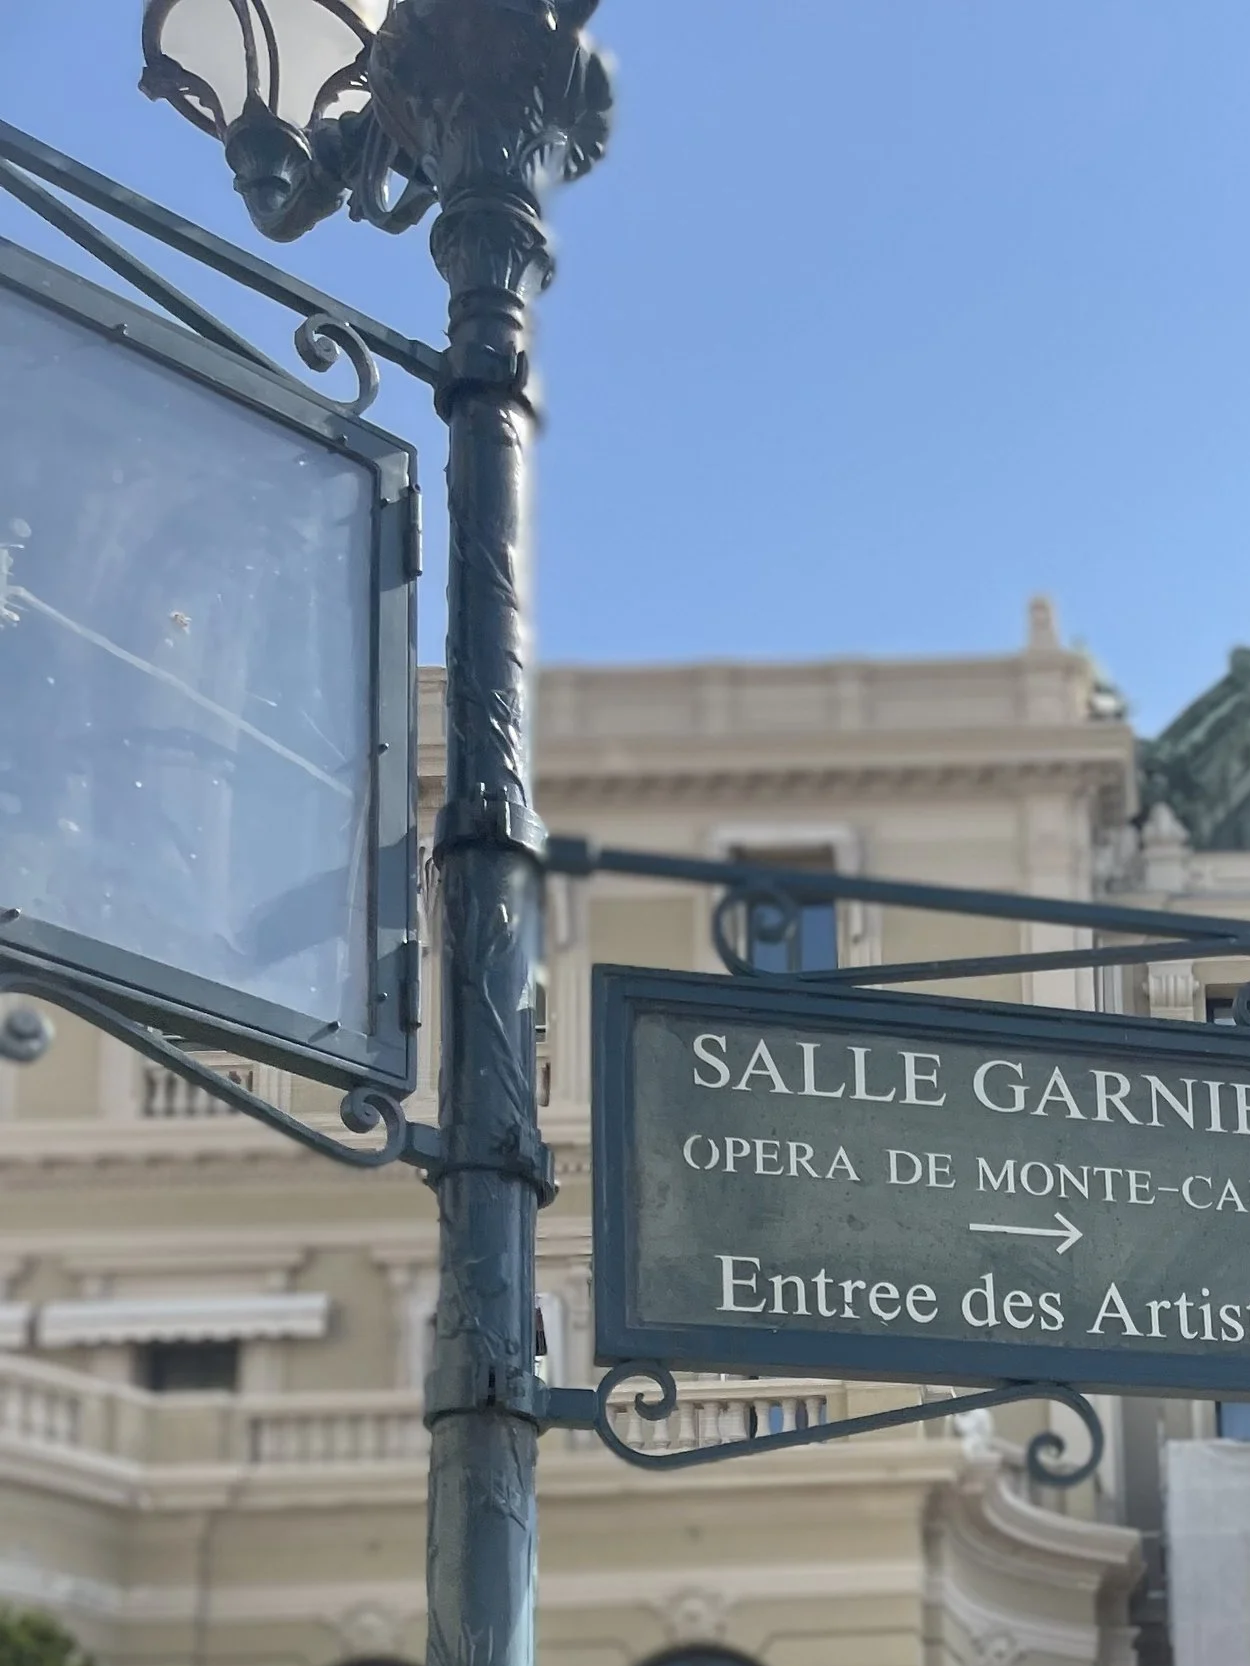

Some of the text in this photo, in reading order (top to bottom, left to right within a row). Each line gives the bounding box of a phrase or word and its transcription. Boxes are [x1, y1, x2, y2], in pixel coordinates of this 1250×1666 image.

[692, 1032, 948, 1107] SALLE
[683, 1133, 861, 1182] OPERA
[886, 1149, 956, 1188] DE
[714, 1253, 940, 1325] Entree
[960, 1271, 1065, 1332] des
